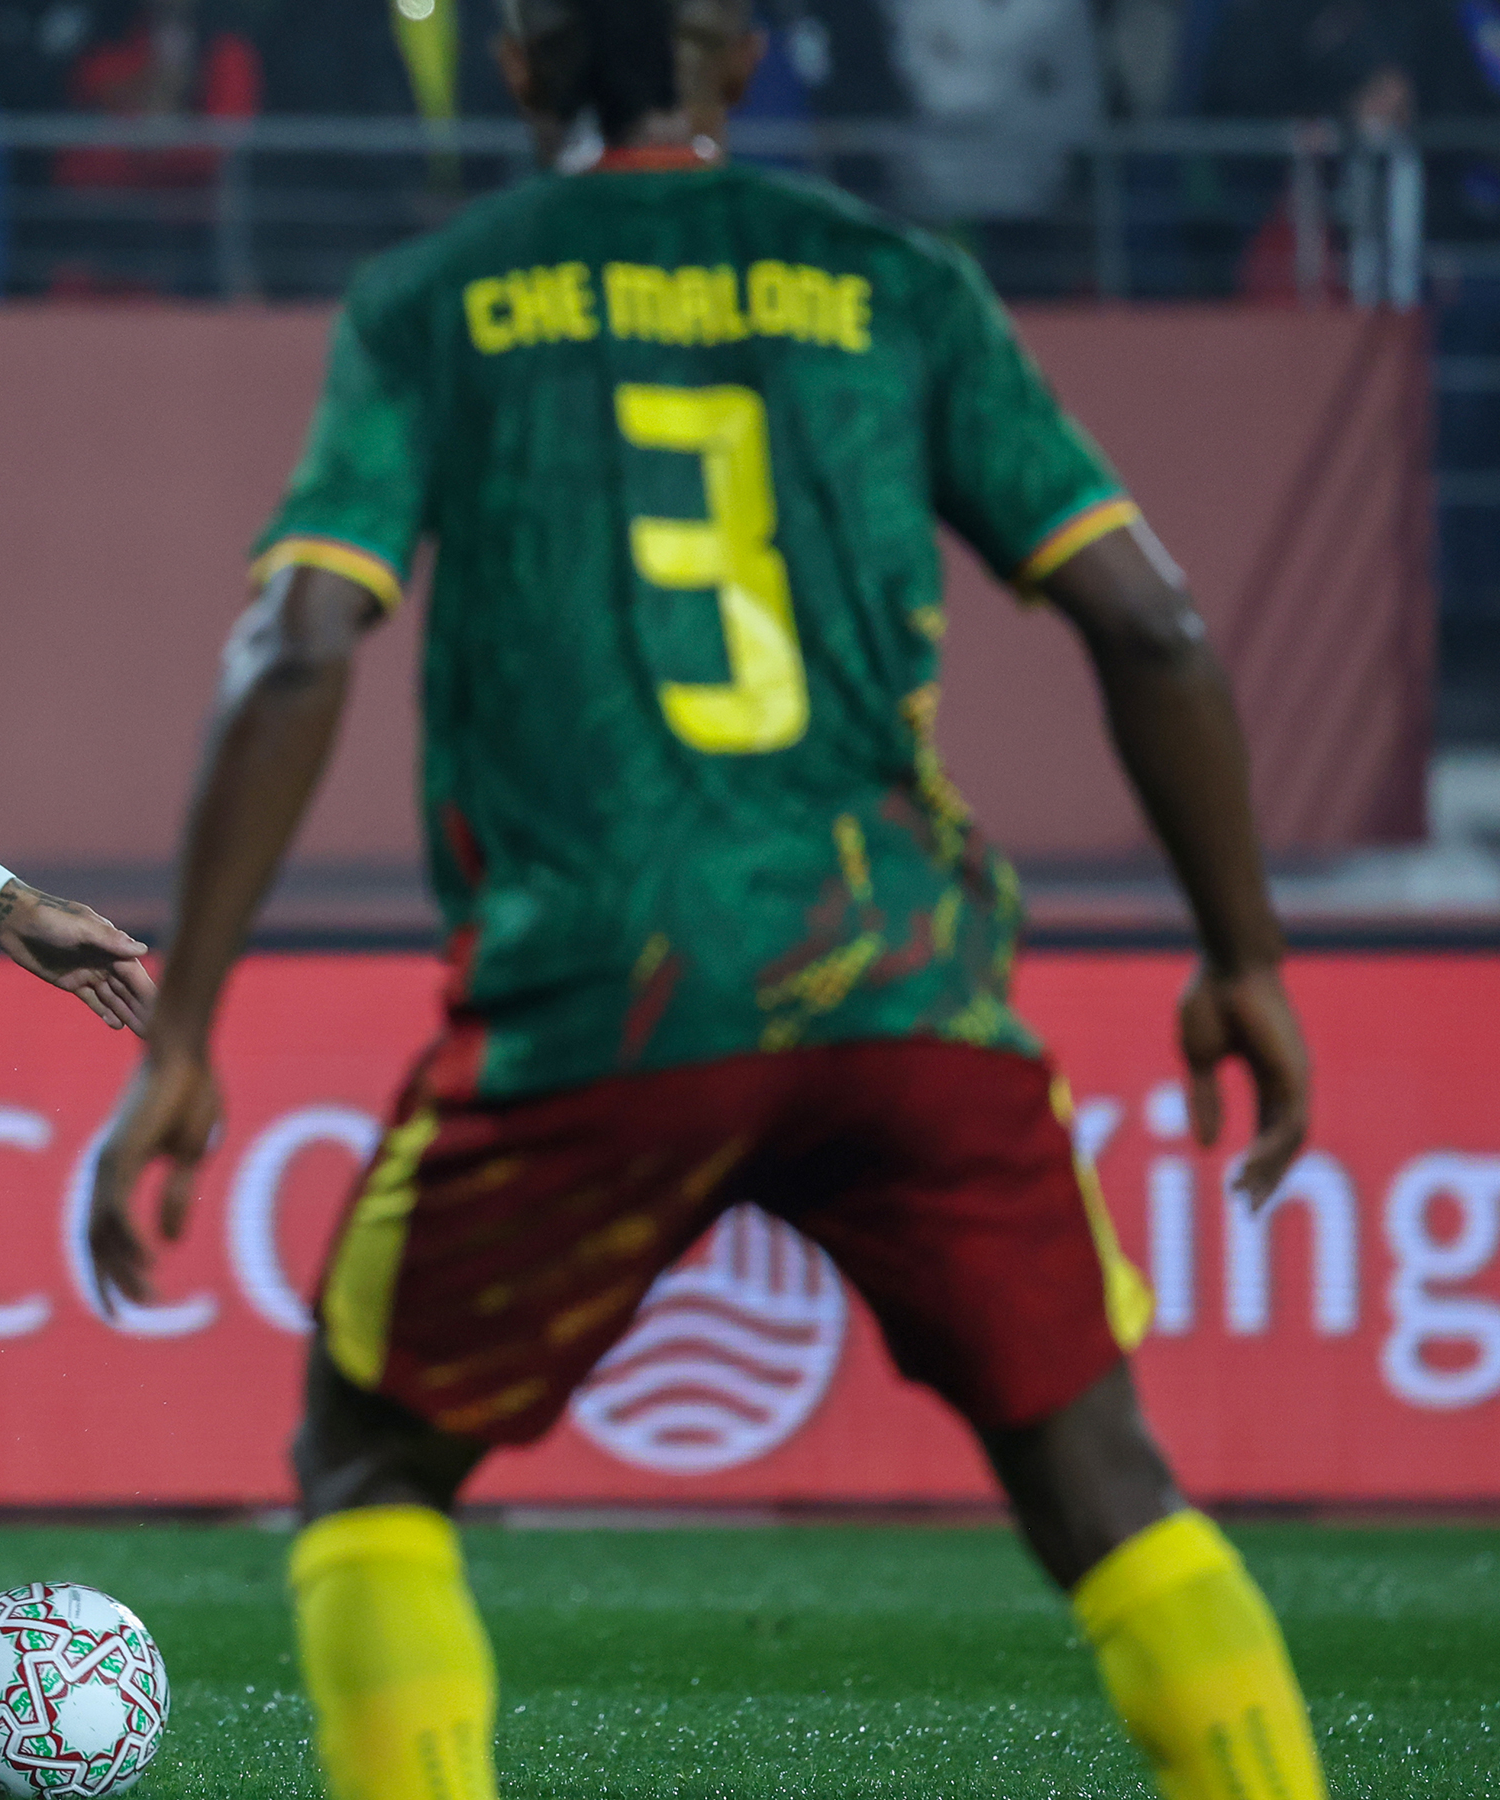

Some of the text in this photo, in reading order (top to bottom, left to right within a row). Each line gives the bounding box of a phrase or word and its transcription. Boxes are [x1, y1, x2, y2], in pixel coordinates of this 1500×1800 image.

[463, 259, 872, 355] CHE MALONE
[613, 382, 811, 755] 3
[1071, 1082, 1500, 1410] ing
